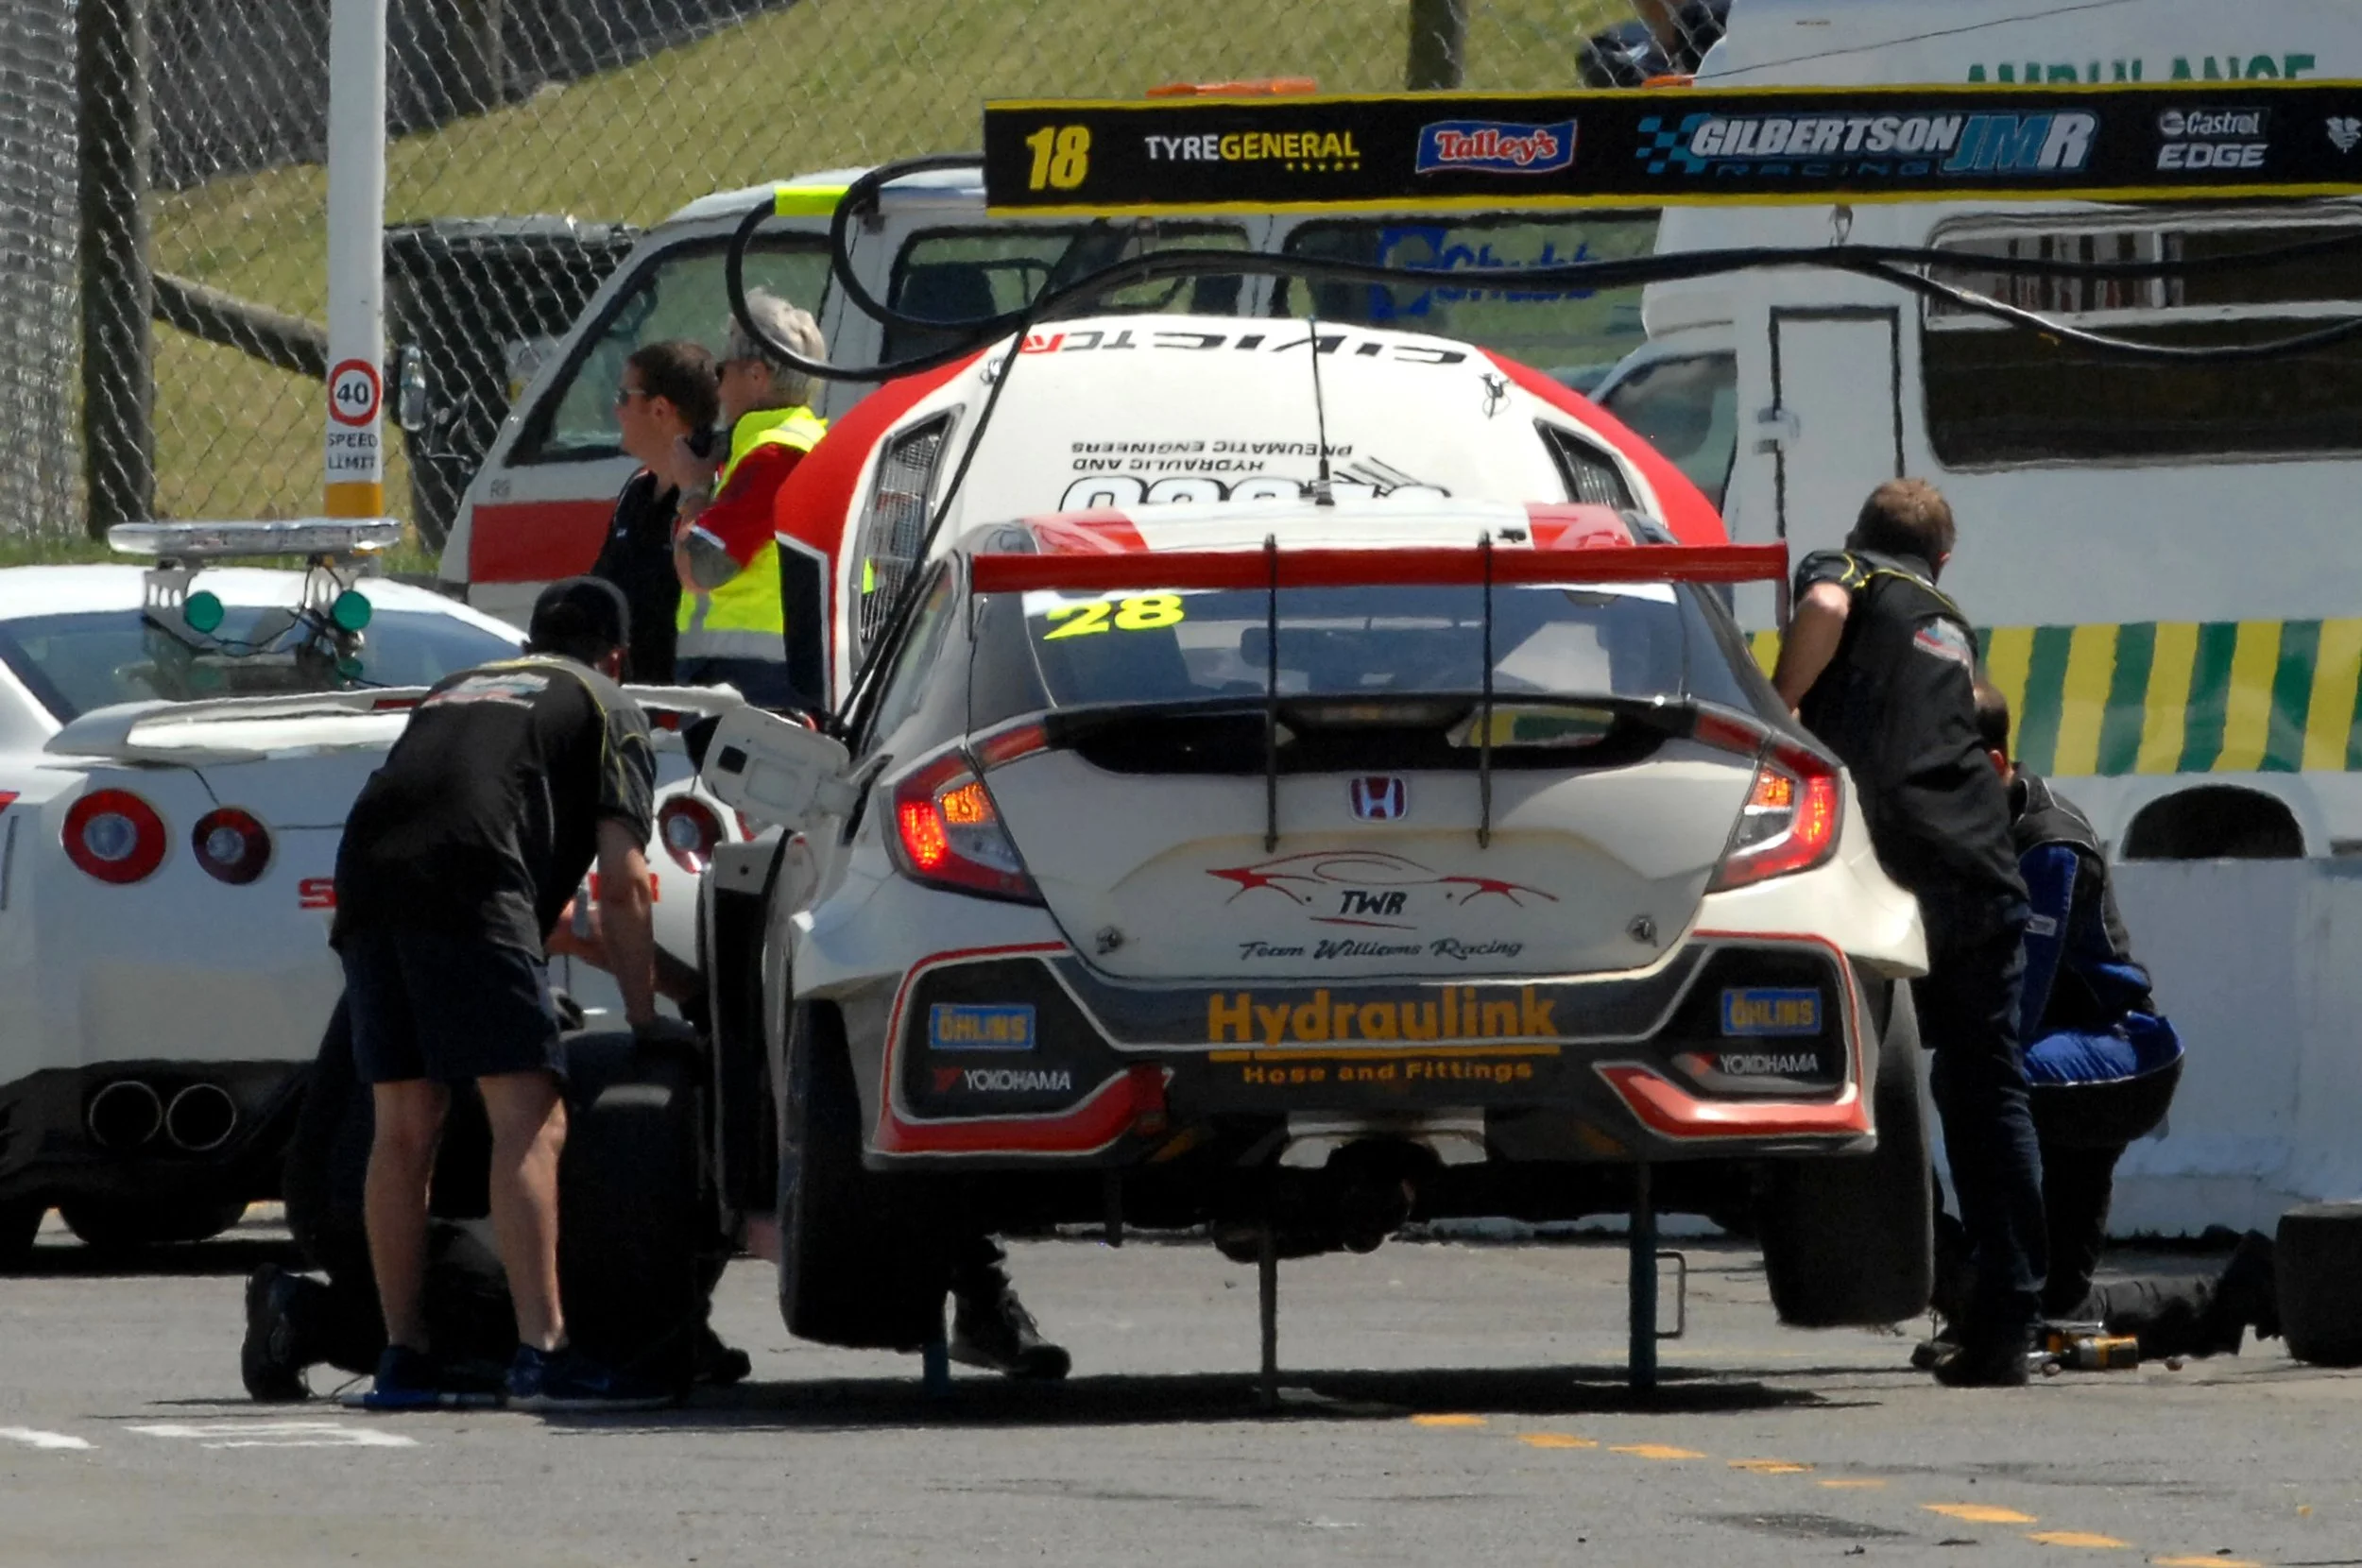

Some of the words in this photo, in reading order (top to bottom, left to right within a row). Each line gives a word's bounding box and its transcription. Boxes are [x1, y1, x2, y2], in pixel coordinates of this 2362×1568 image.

[2186, 111, 2260, 134] Castrol
[1144, 131, 1361, 162] TYREGENERAL
[1434, 129, 1559, 165] Talley's
[1691, 116, 1962, 156] GILBERTSON
[1943, 113, 2096, 171] JMR
[1026, 125, 1090, 190] 18
[2157, 143, 2268, 169] EDGE
[1019, 331, 1136, 354] TCR
[1153, 332, 1467, 365] CIVIC
[336, 382, 368, 405] 40
[328, 433, 378, 449] SPEED
[1070, 440, 1206, 455] ENGINEERS
[1213, 440, 1353, 456] PNEUMATIC
[328, 453, 376, 470] LIMIT
[1072, 457, 1120, 471] AND
[1132, 457, 1265, 472] HYDRAULIC
[1043, 594, 1185, 640] 28
[1340, 890, 1408, 915] TWR
[1239, 941, 1305, 961] Team
[1313, 939, 1422, 961] Williams
[1429, 937, 1524, 961] Racing
[1208, 984, 1560, 1046] Hydraulink
[1242, 1065, 1326, 1084] Hose
[1338, 1064, 1395, 1082] and
[1406, 1060, 1534, 1082] Fittings
[1719, 1053, 1819, 1075] YOKOHAMA
[964, 1068, 1071, 1092] YOKOHAMA
